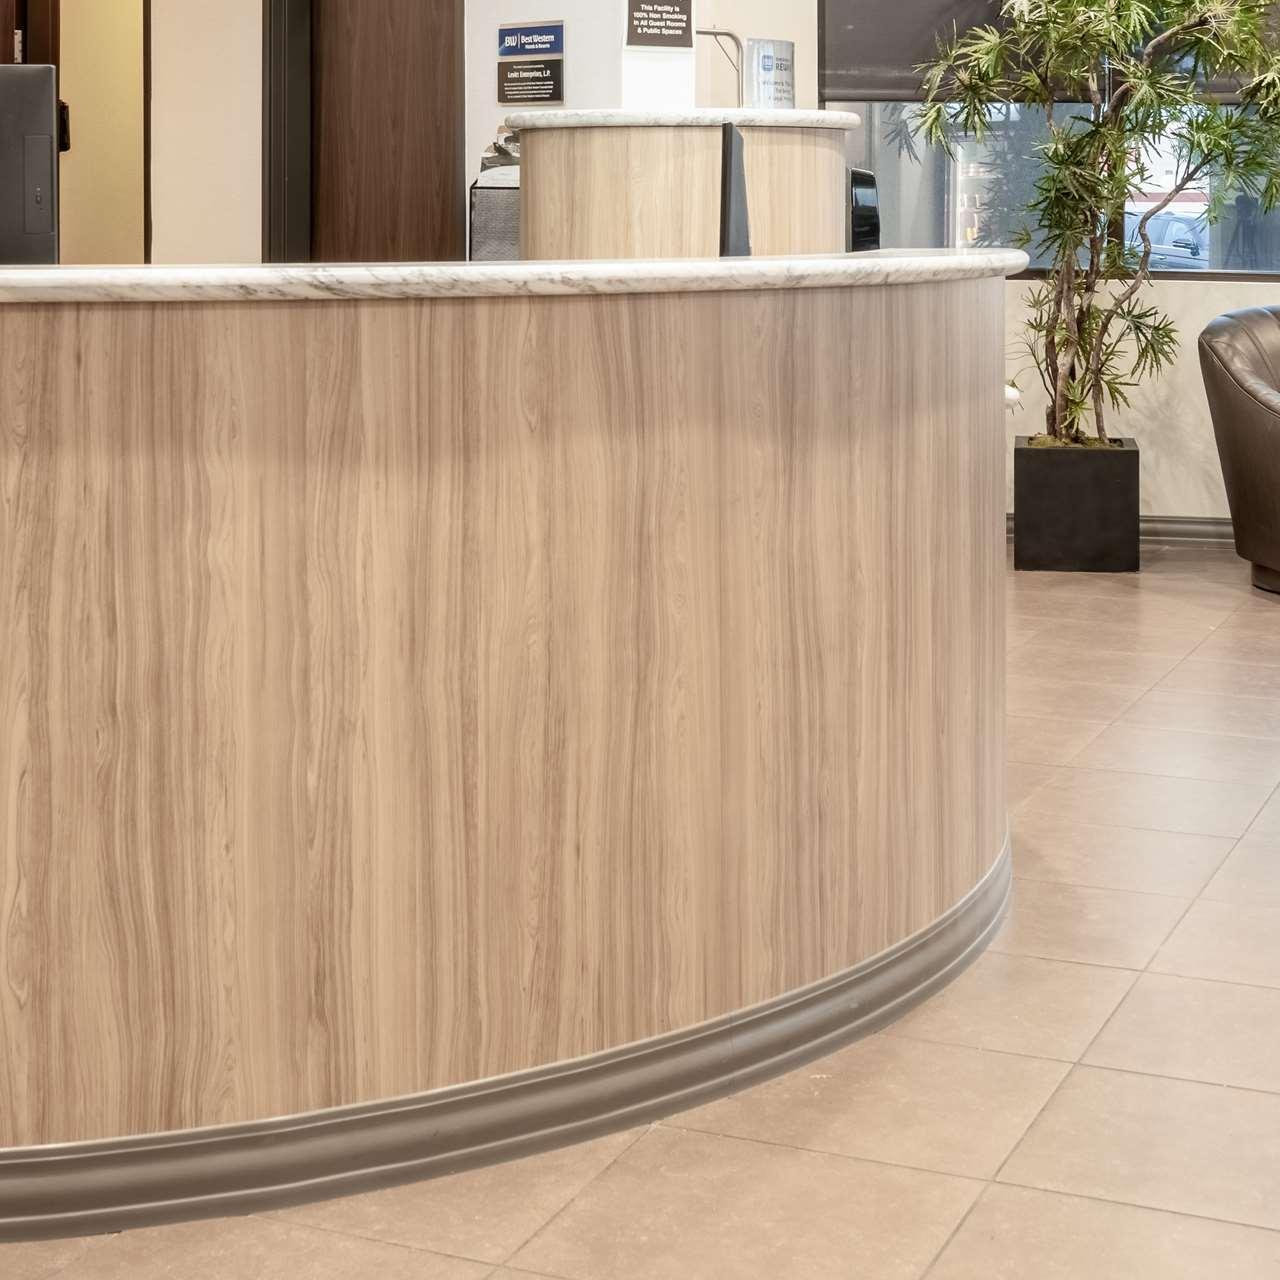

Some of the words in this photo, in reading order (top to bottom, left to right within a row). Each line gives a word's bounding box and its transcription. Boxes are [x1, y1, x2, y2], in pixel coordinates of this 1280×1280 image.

[653, 4, 674, 13] Facility
[633, 11, 648, 19] 100%
[662, 13, 687, 21] Smoking
[666, 20, 687, 28] Rooms
[642, 27, 661, 35] Public
[661, 28, 683, 36] Spaces
[505, 35, 518, 47] BW
[521, 35, 533, 44] Best
[532, 34, 555, 43] Western
